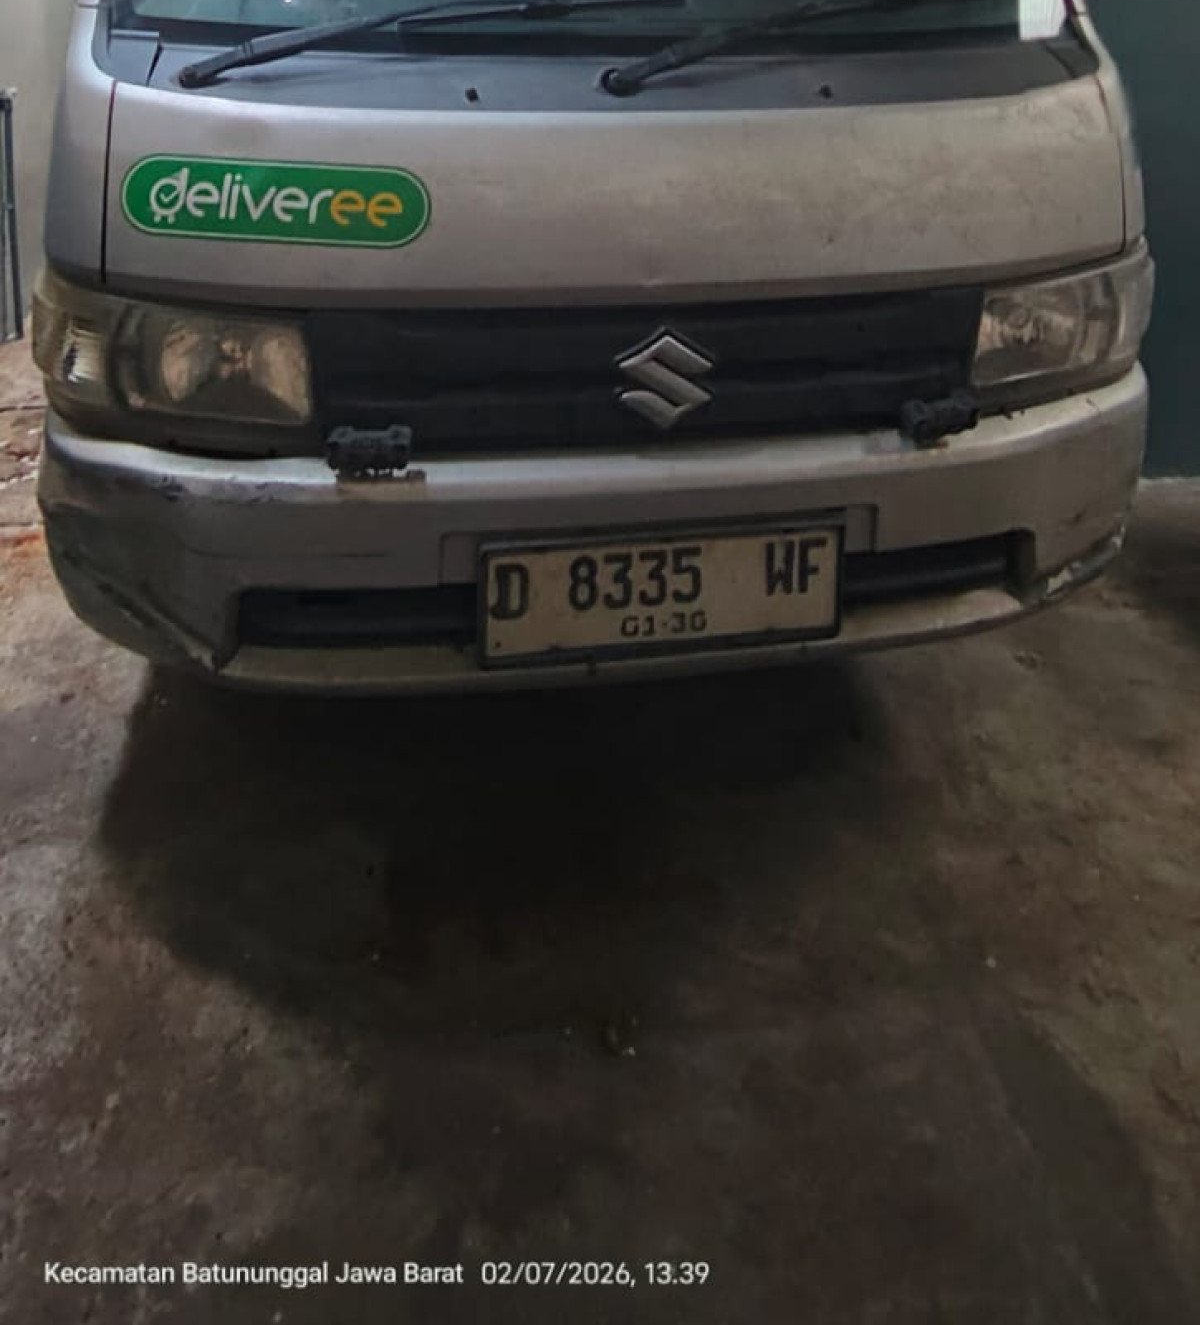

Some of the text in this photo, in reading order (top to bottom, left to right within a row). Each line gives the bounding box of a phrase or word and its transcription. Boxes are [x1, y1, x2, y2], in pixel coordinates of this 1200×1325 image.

[150, 167, 403, 227] deliveree
[490, 537, 828, 621] D 8335 WF
